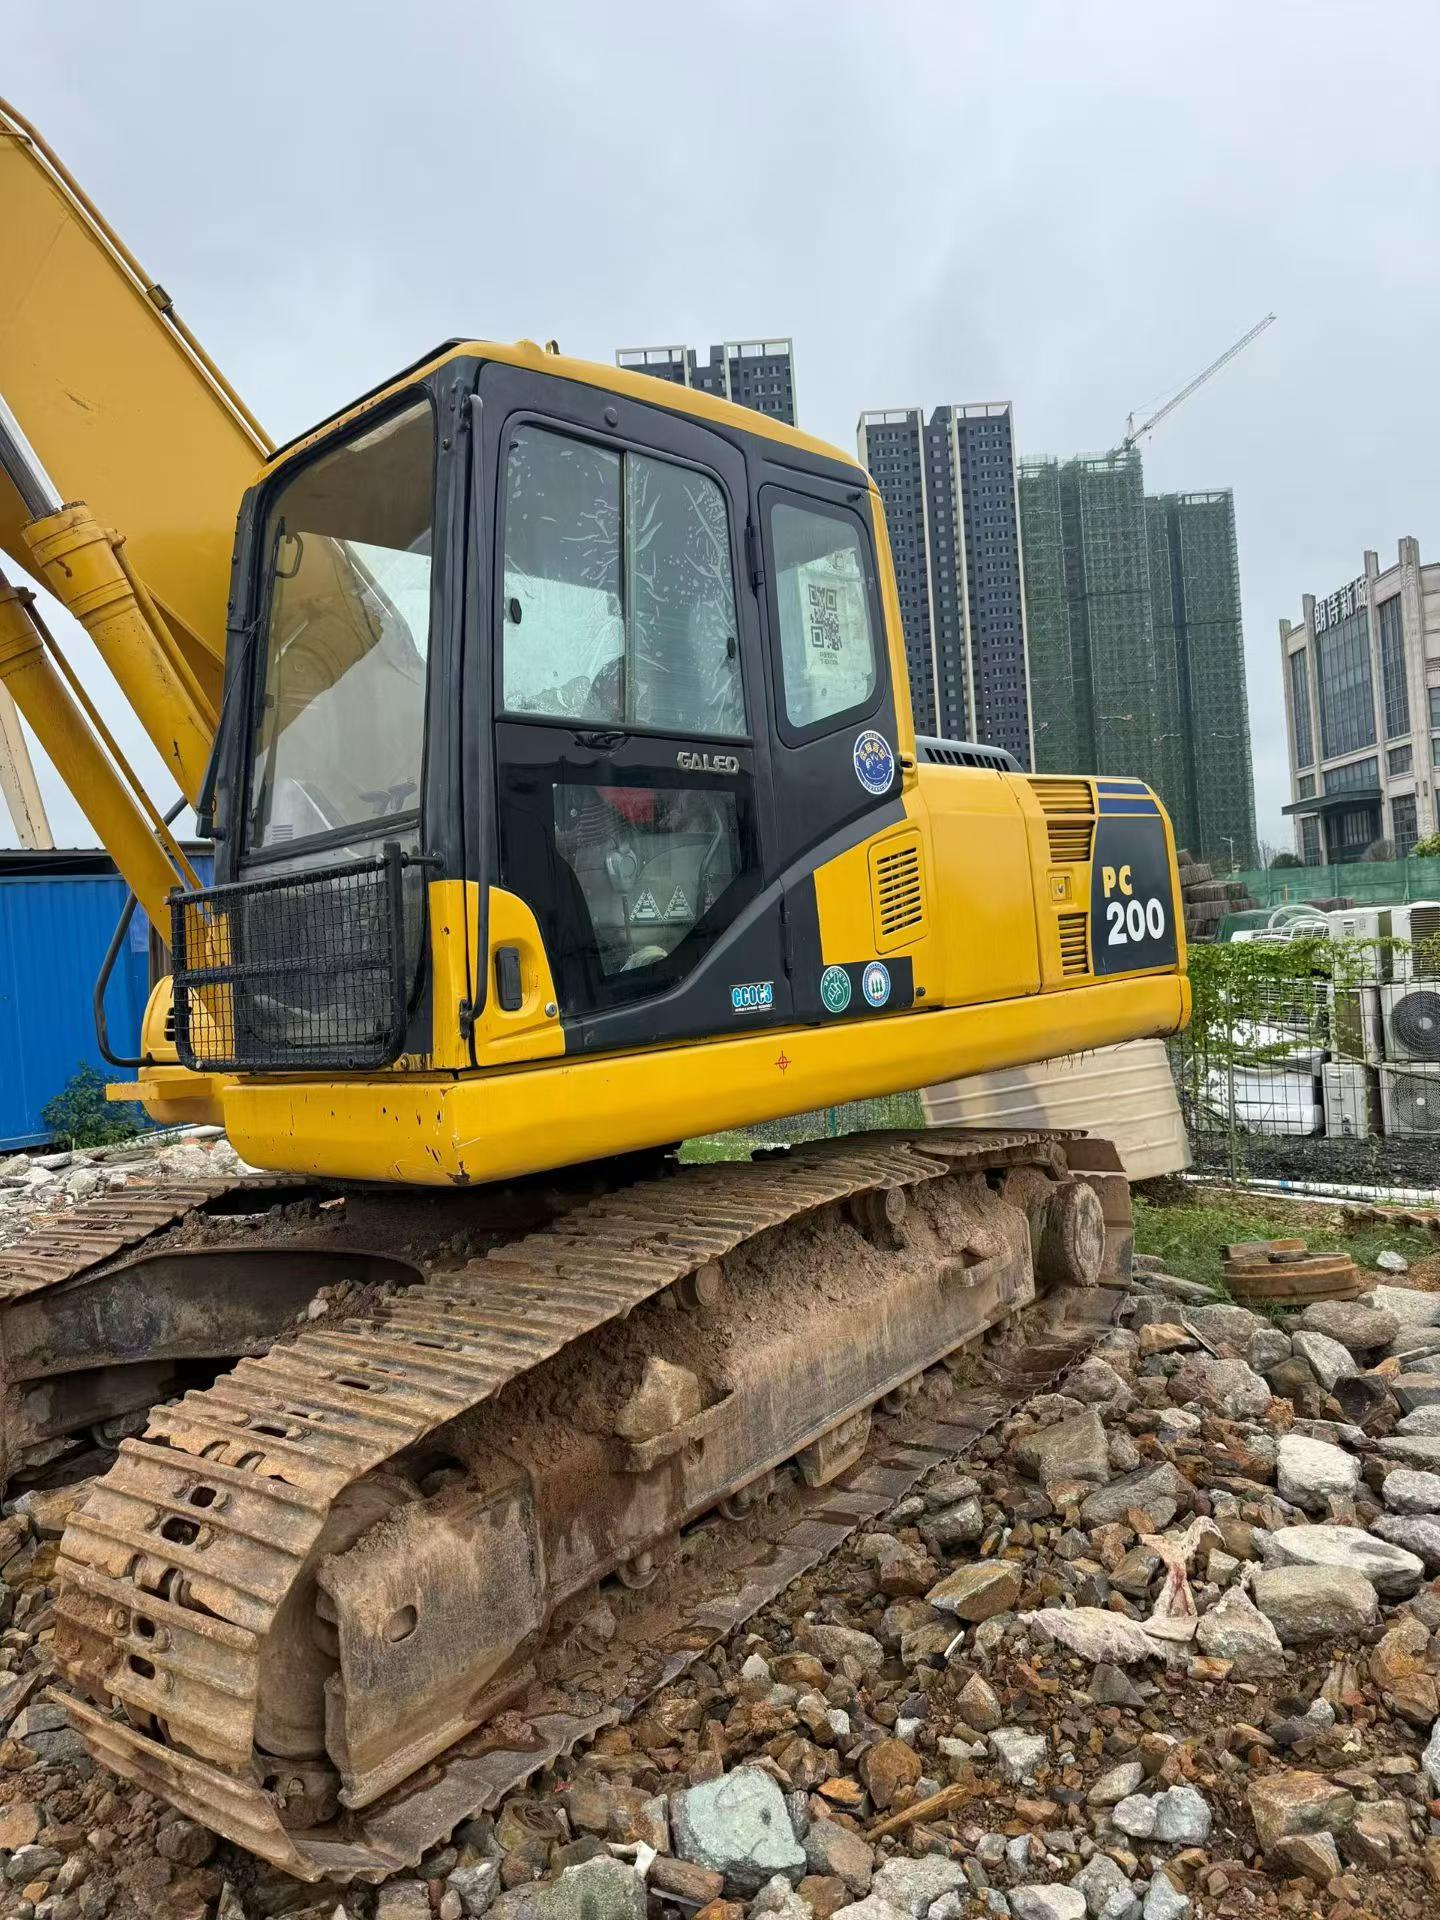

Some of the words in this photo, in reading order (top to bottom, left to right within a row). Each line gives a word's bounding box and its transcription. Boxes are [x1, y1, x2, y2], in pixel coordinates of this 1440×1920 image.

[677, 751, 740, 774] GALEO
[1102, 865, 1133, 898] PC
[1106, 898, 1165, 946] 200
[732, 983, 773, 1008] ecot3
